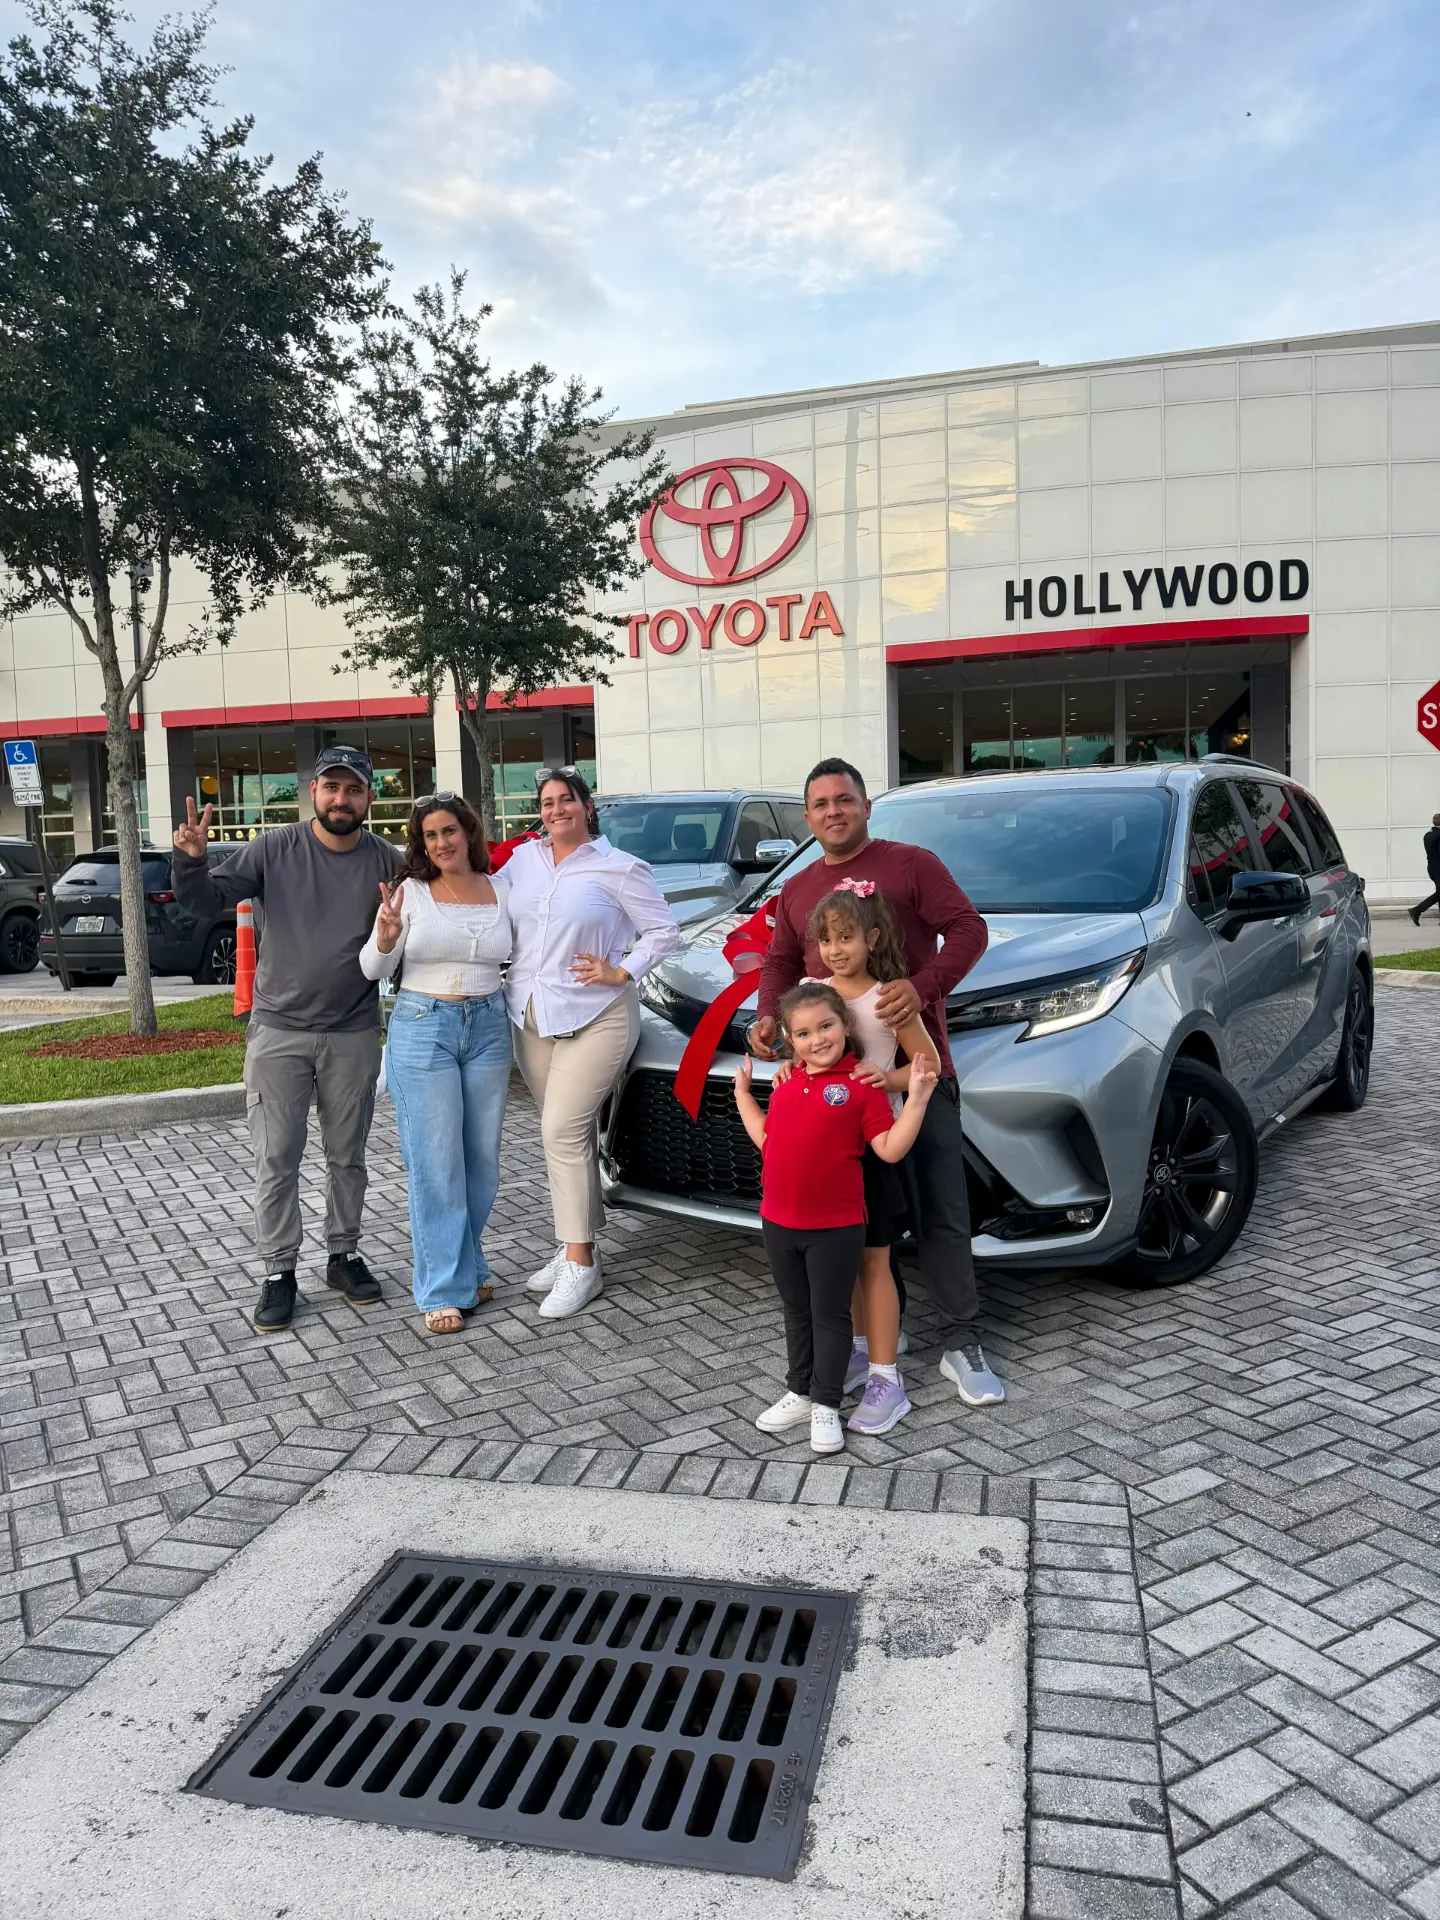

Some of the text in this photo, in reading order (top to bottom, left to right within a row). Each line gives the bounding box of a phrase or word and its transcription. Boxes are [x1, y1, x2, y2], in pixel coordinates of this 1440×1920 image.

[1006, 558, 1309, 620] HOLLYWOOD
[621, 591, 844, 658] TOYOTA
[770, 1772, 796, 1827] 032817
